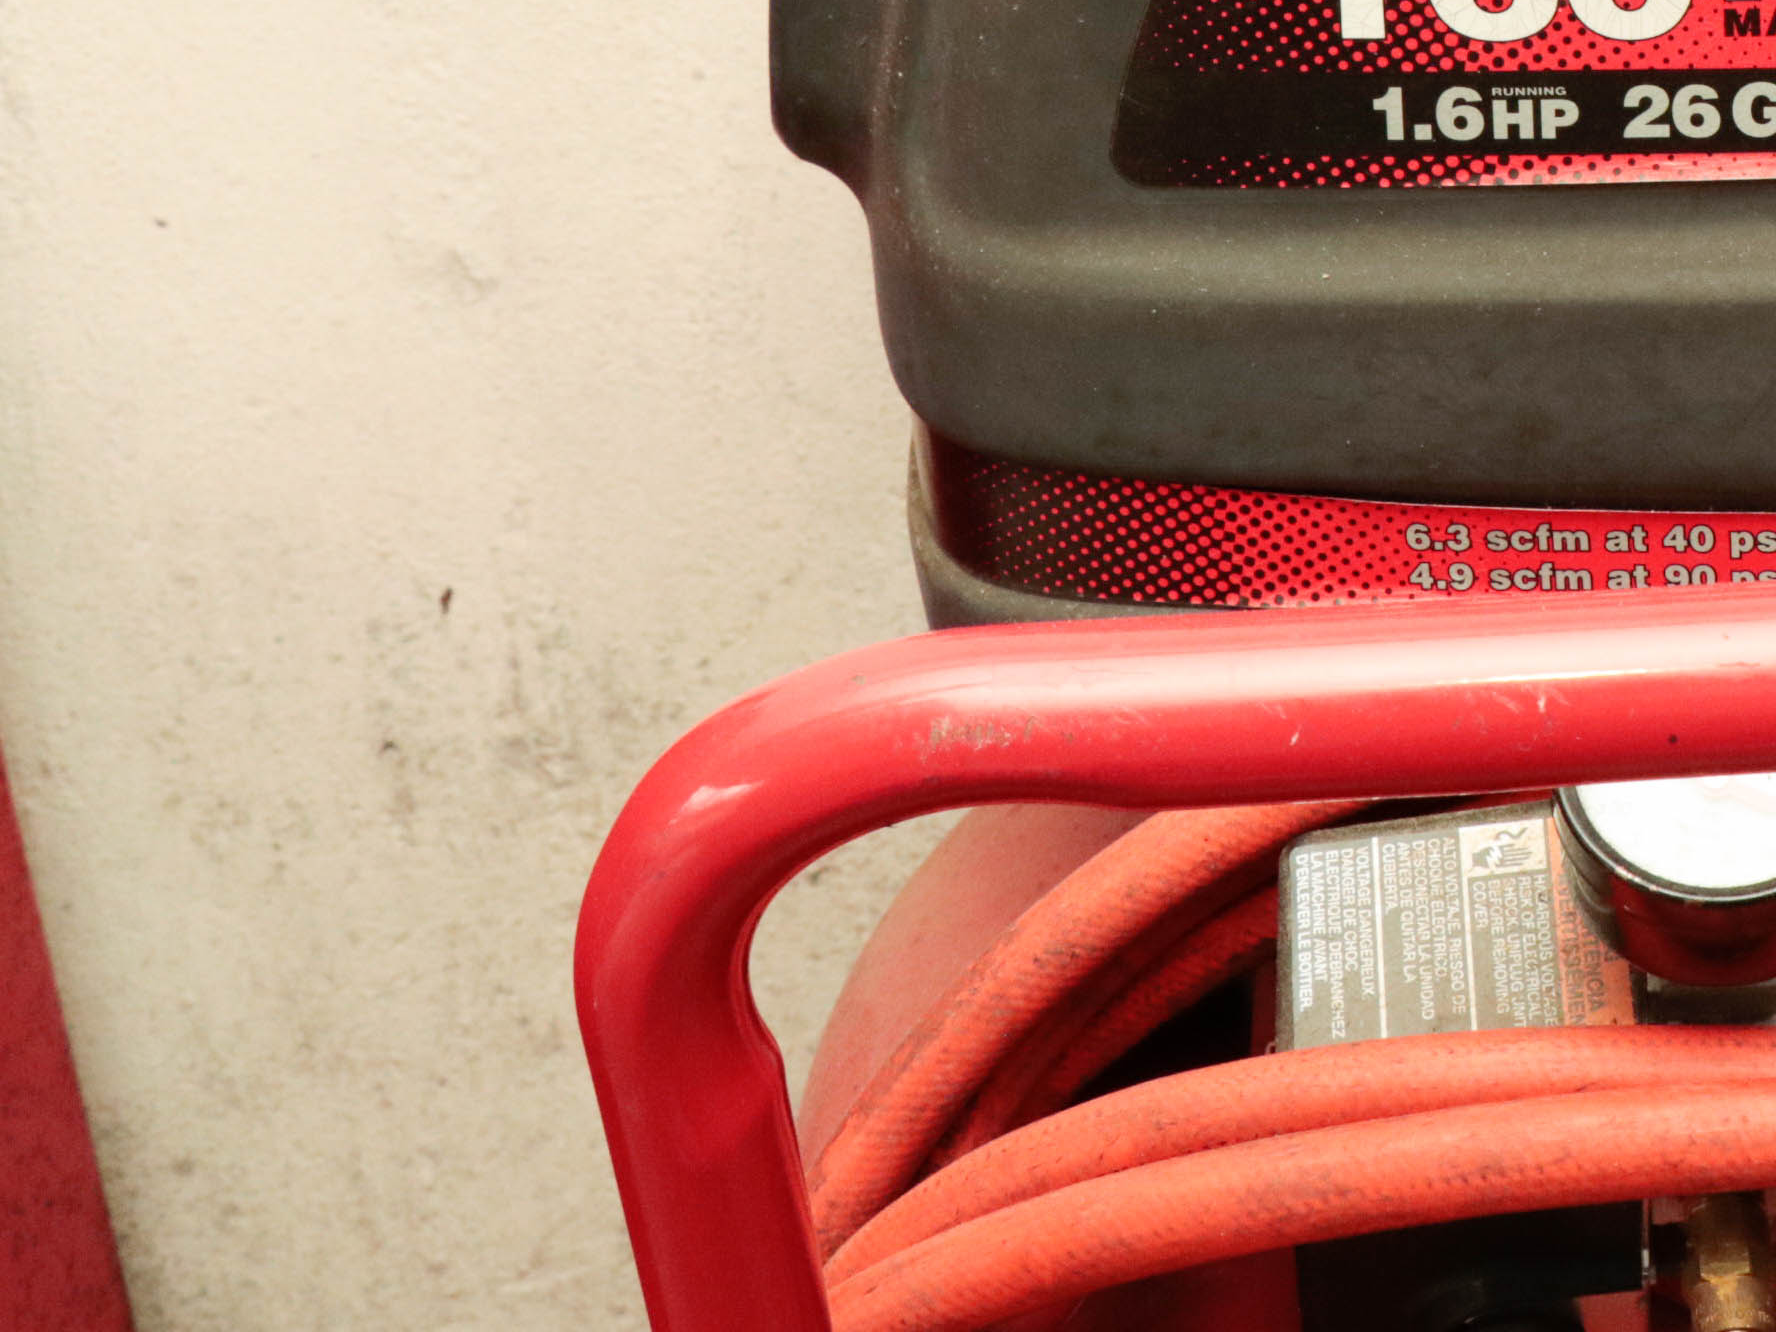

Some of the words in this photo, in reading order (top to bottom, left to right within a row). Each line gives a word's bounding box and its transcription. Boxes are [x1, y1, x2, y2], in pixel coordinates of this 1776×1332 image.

[1492, 86, 1566, 96] RUNNING
[1623, 84, 1721, 139] 26
[1405, 522, 1471, 552] 6.3
[1486, 522, 1590, 552] scfm
[1604, 524, 1649, 553] at
[1663, 524, 1716, 553] 40
[1408, 561, 1475, 591] 4.9
[1489, 561, 1593, 591] scfm
[1607, 564, 1650, 589] at
[1664, 564, 1718, 587] 90
[1311, 852, 1323, 868] LA
[1398, 842, 1412, 886] ANTES
[1428, 838, 1443, 895] CHOQUE
[1443, 837, 1456, 871] ALTO
[1296, 854, 1310, 929] D'ENLEVER
[1341, 848, 1355, 905] DANGER
[1356, 847, 1371, 907] VOLTAGE
[1400, 889, 1413, 908] DE
[1413, 840, 1430, 940] DESCONECTAR
[1518, 876, 1532, 907] RISK
[1312, 871, 1325, 935] MACHINE
[1344, 908, 1356, 927] DE
[1488, 879, 1504, 935] BEFORE
[1521, 911, 1534, 929] OF
[1298, 932, 1311, 948] LE
[1344, 930, 1358, 972] CHOC
[1401, 911, 1416, 962] QUITAR
[1418, 944, 1431, 963] LA
[1314, 939, 1328, 981] AVANT
[1403, 966, 1416, 983] LA
[1449, 938, 1464, 991] RIESGO
[1493, 939, 1509, 1014] REMOVING
[1507, 935, 1523, 992] UNPLUG
[1523, 935, 1541, 1020] ELECTRICAL
[1329, 942, 1345, 1039] DEBRANCHEZ
[1419, 967, 1434, 1020] UNIDAD
[1452, 994, 1466, 1014] DE
